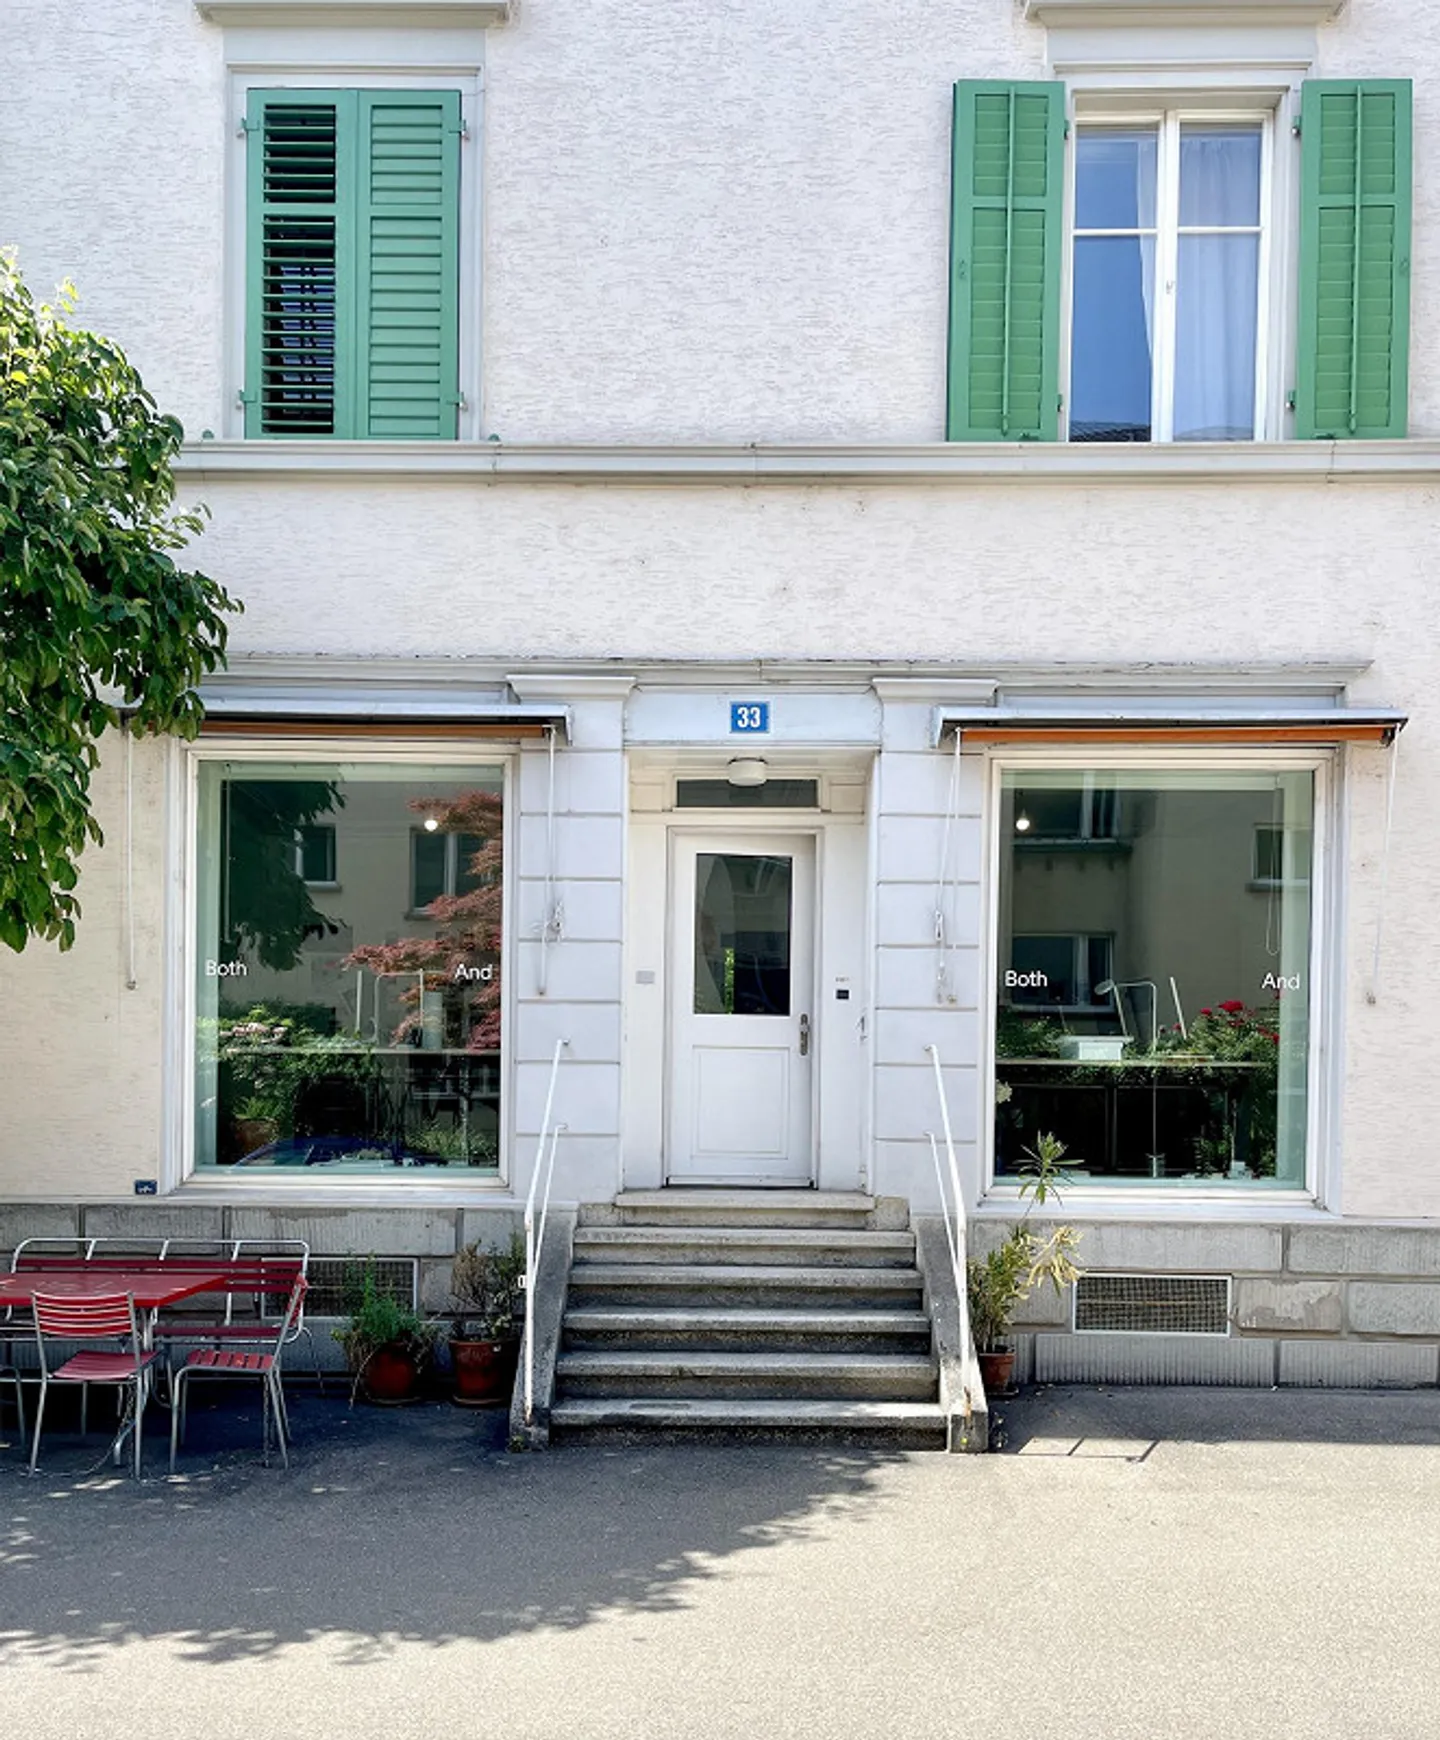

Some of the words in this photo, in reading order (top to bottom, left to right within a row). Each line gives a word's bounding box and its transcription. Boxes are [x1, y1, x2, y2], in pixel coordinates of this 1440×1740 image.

[737, 706, 761, 728] 33
[205, 959, 247, 976] Both
[455, 963, 493, 980] And
[1004, 969, 1048, 987] Both
[1261, 972, 1300, 990] And
